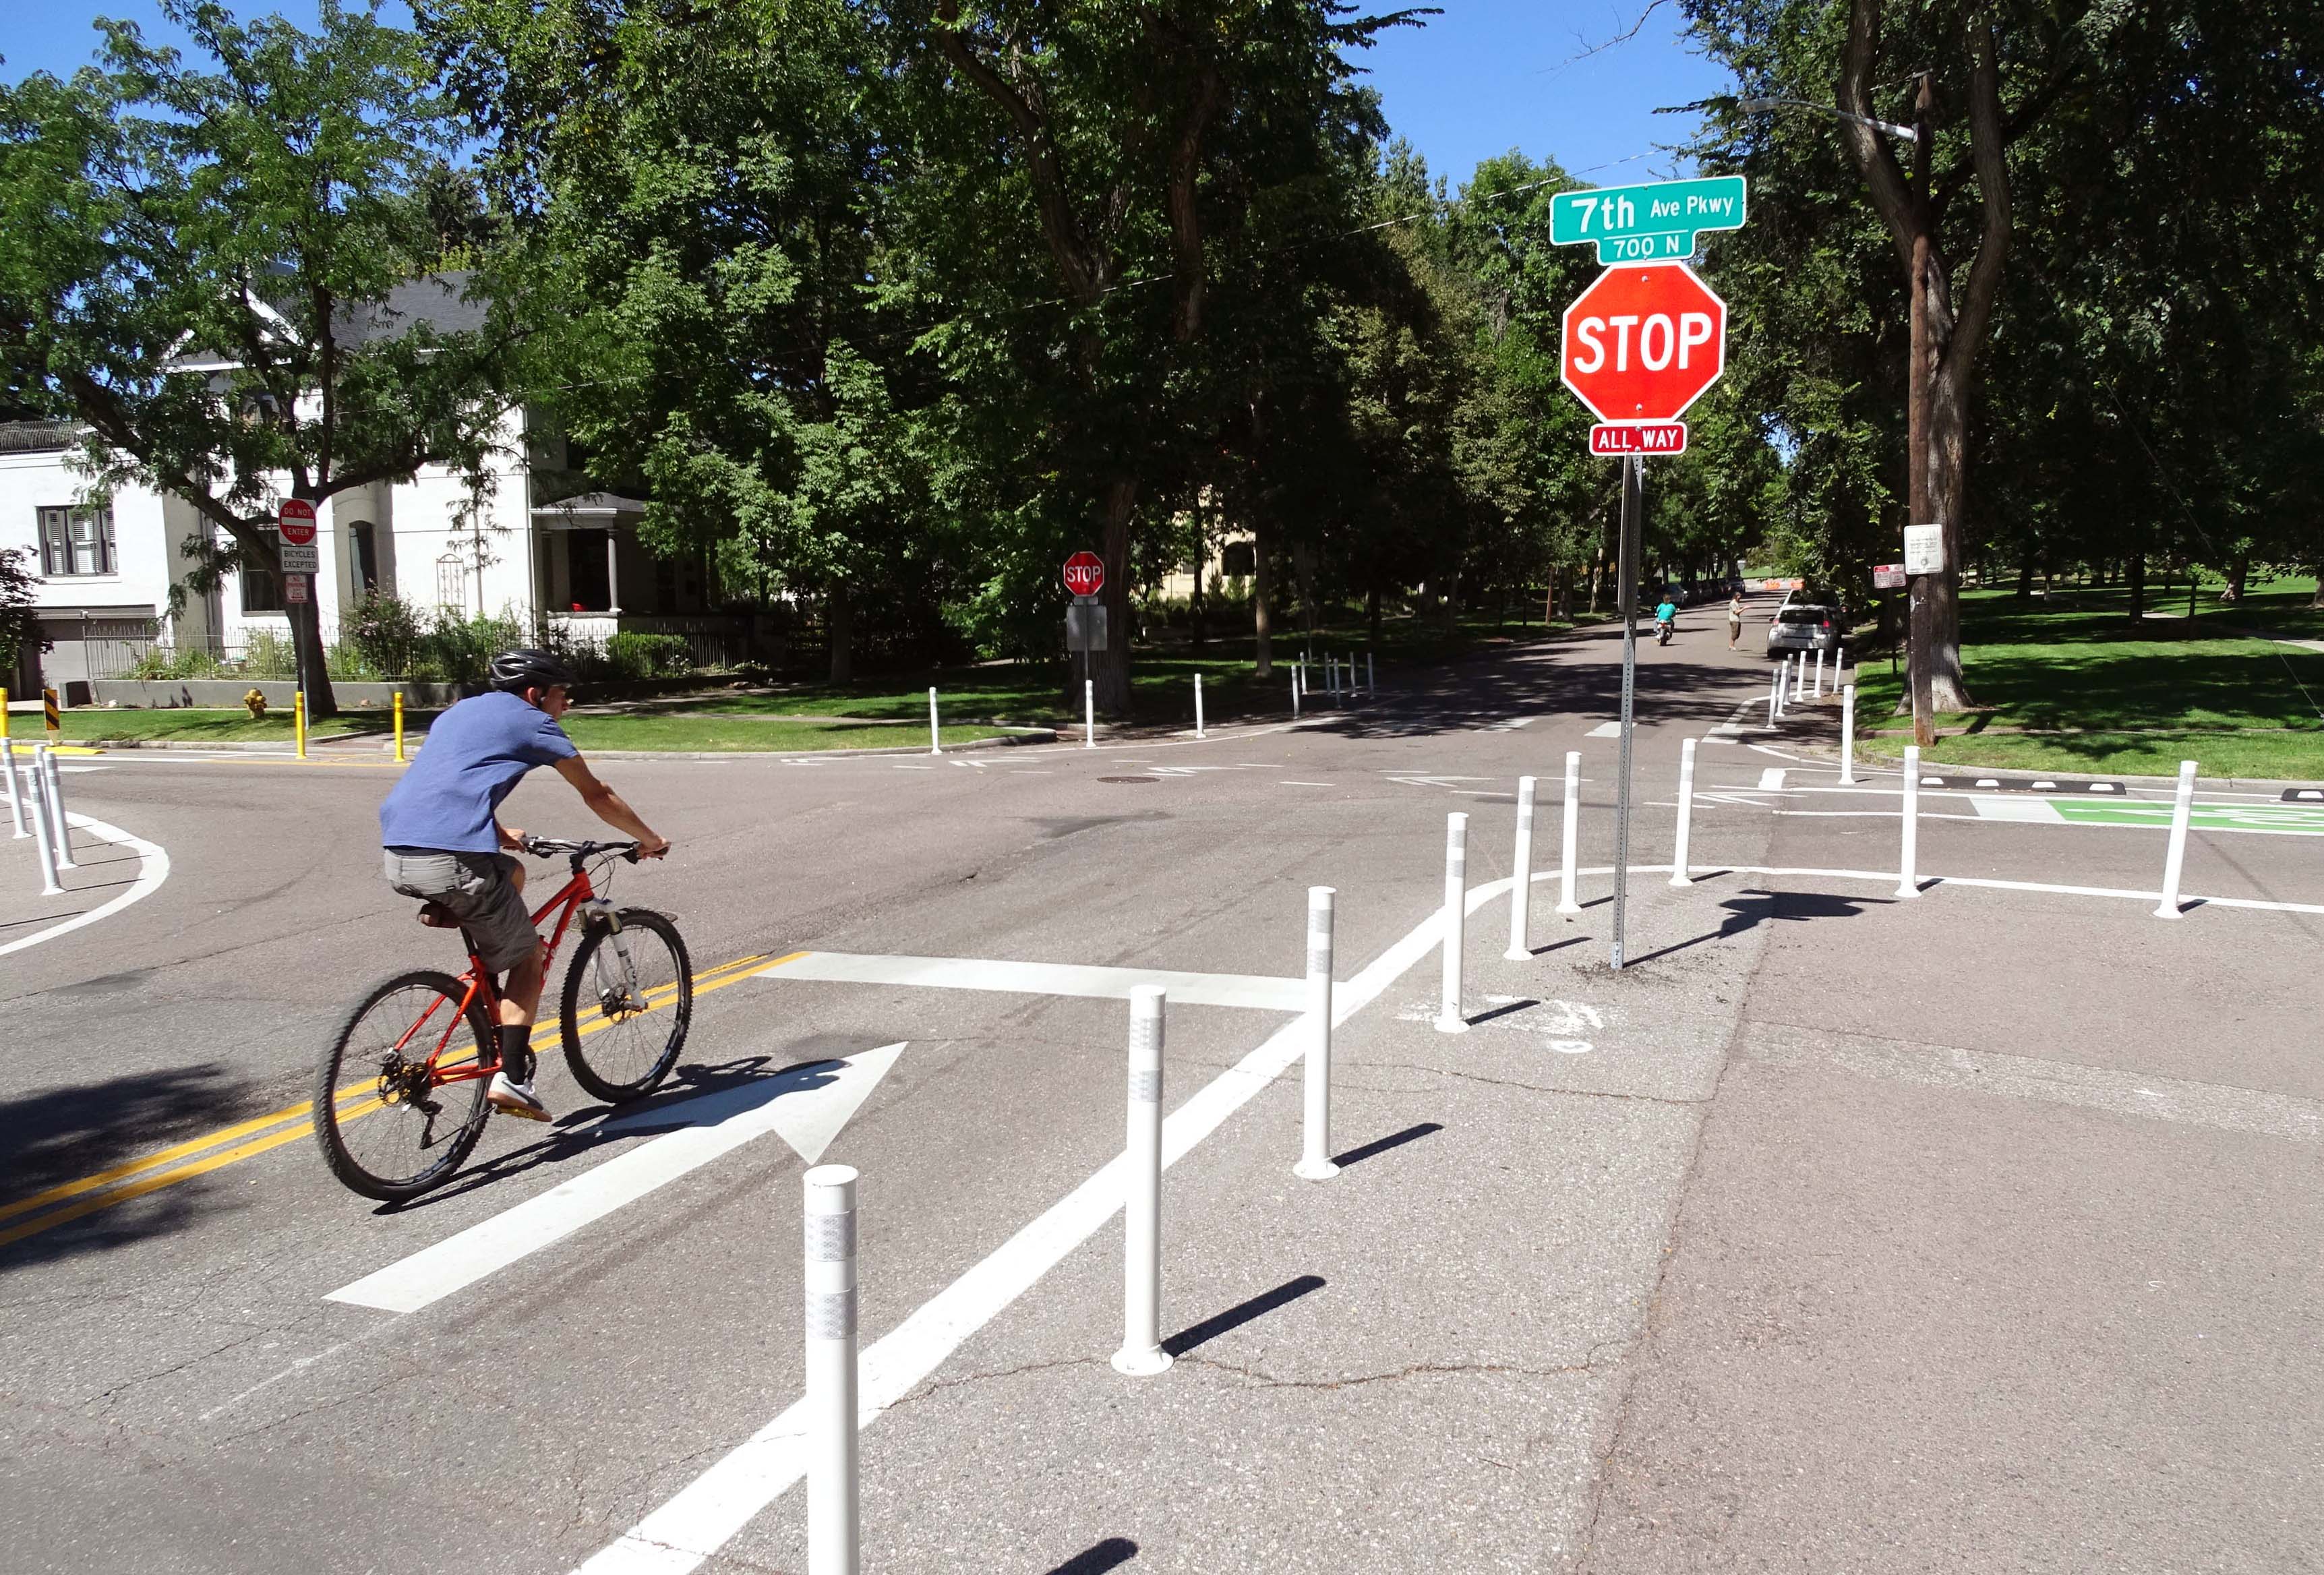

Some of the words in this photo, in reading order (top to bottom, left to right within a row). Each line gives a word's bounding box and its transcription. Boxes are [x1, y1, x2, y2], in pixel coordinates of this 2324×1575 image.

[1572, 194, 1634, 233] 7th
[1650, 198, 1680, 218] Ave
[1687, 195, 1734, 217] Pkwy
[1613, 237, 1655, 258] 700
[1666, 235, 1679, 254] N
[1574, 312, 1712, 374] STOP
[1598, 430, 1632, 449] ALL
[1642, 429, 1679, 448] WAY
[297, 508, 311, 516] NOT
[287, 527, 309, 536] ENTER
[284, 549, 316, 558] BICYCLES
[283, 560, 317, 569] EXCEPTED
[1067, 566, 1101, 583] STOP
